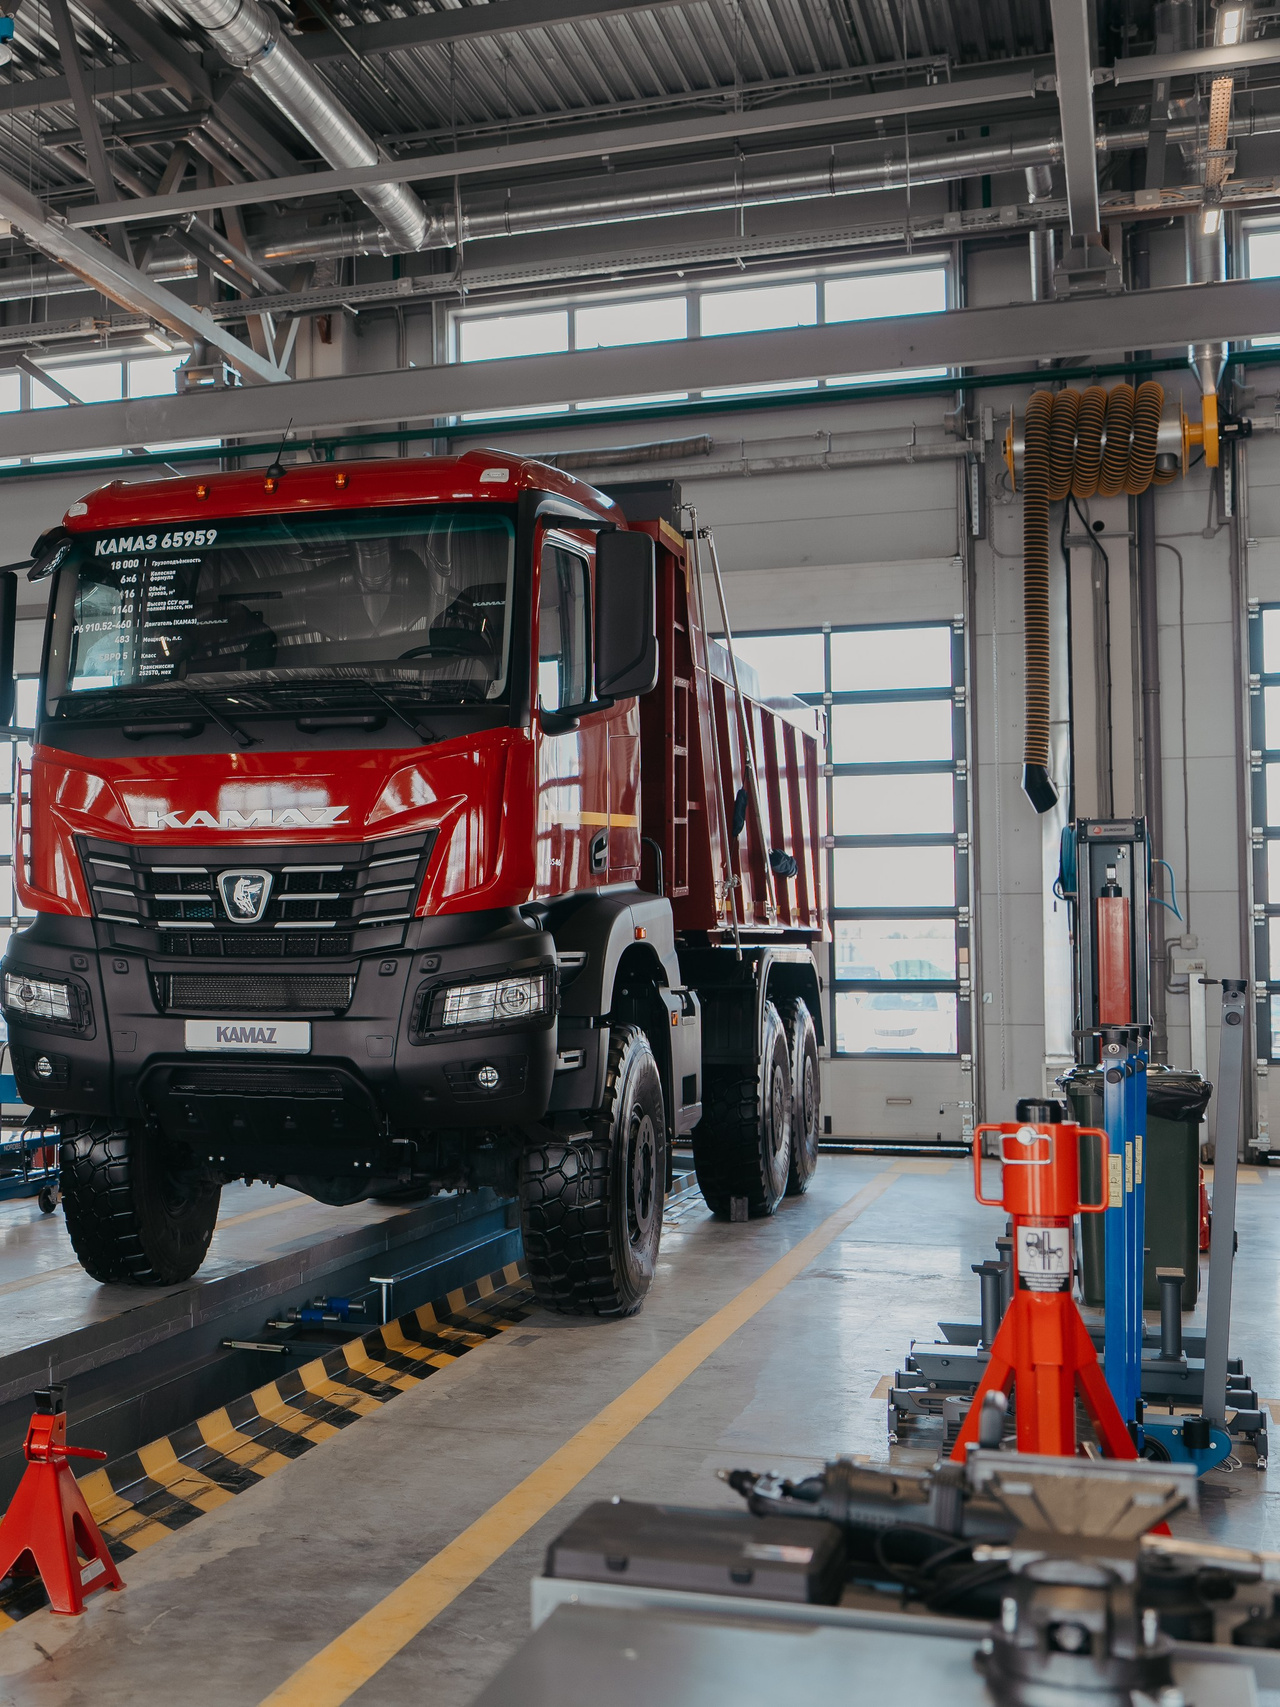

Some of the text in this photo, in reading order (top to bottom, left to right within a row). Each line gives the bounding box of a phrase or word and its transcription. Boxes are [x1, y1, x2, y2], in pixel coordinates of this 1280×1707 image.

[95, 529, 218, 556] КАМАЗ 65959
[111, 559, 139, 570] 18 000
[85, 619, 132, 633] 910.52-460
[114, 635, 130, 644] 483
[122, 651, 128, 660] 5
[147, 805, 349, 828] KAMAZ
[216, 1026, 277, 1044] KAMAZ
